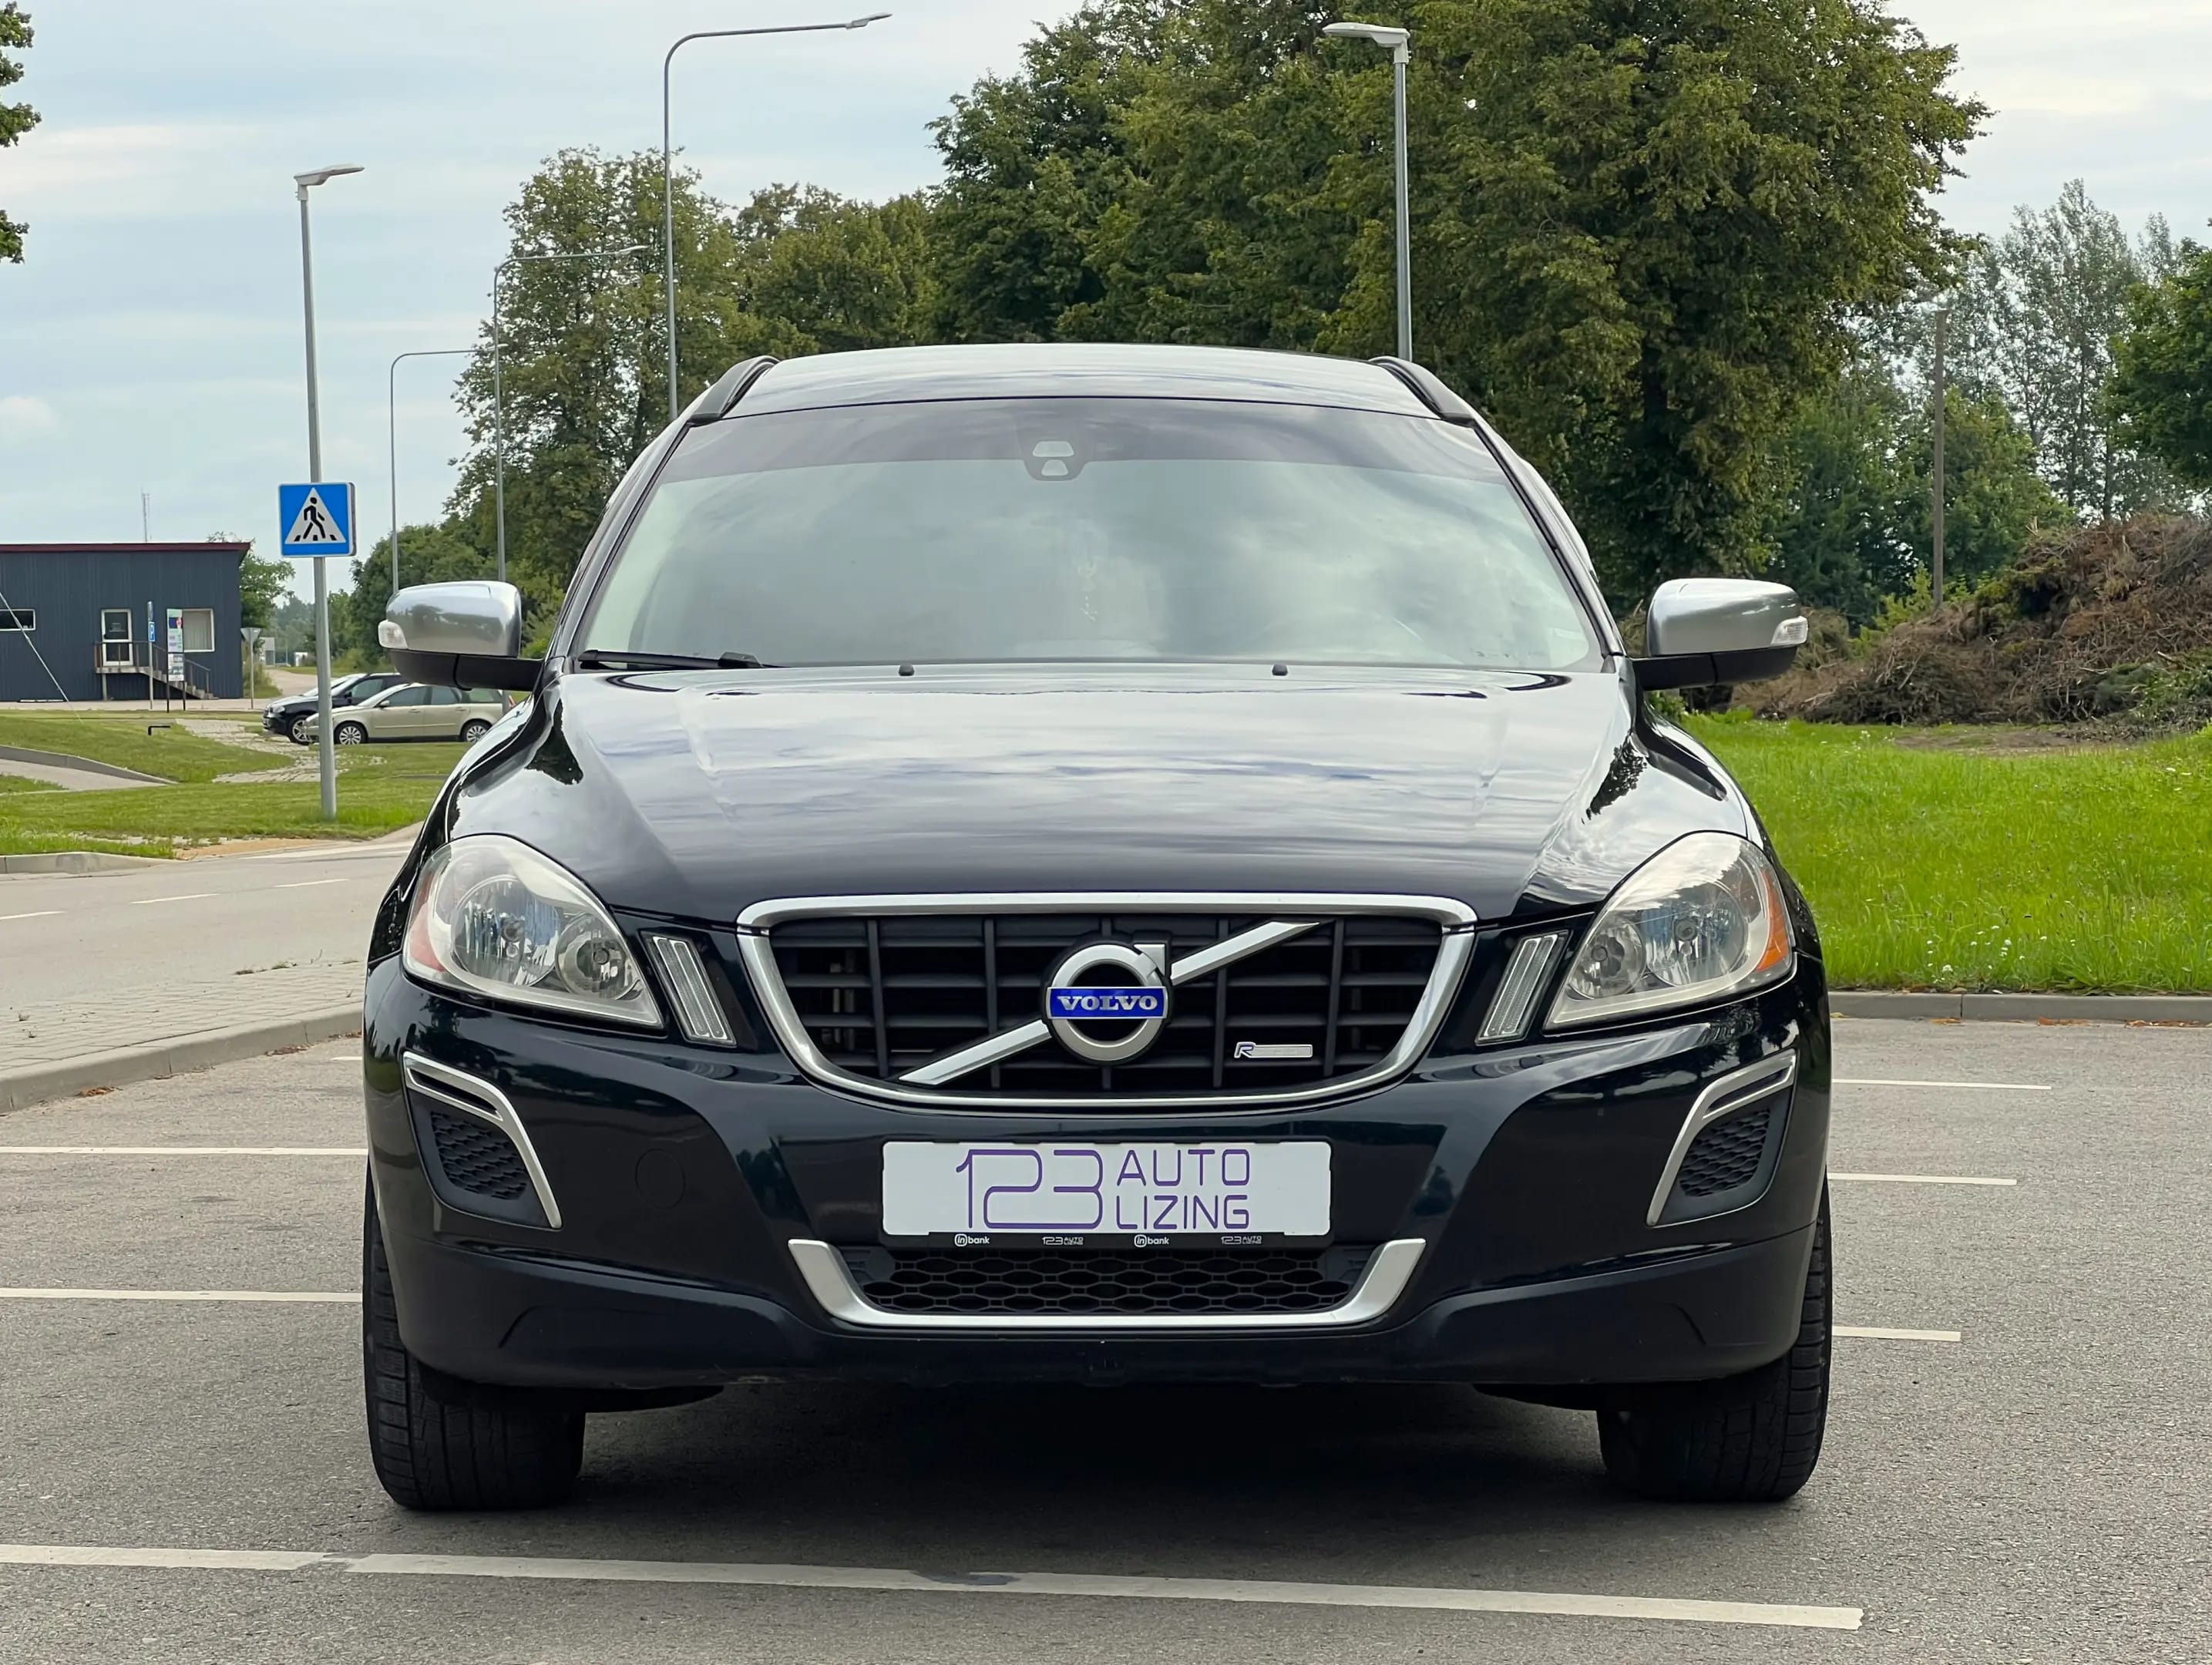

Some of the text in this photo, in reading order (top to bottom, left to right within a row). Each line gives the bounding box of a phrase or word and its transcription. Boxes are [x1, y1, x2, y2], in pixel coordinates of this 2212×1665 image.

[1057, 995, 1158, 1011] VOLVO
[1234, 1042, 1256, 1058] R
[1116, 1149, 1250, 1187] AUTO
[956, 1149, 1103, 1229] 123
[1116, 1195, 1249, 1229] LIZING
[1042, 1236, 1063, 1246] 123
[1221, 1236, 1242, 1245] 123
